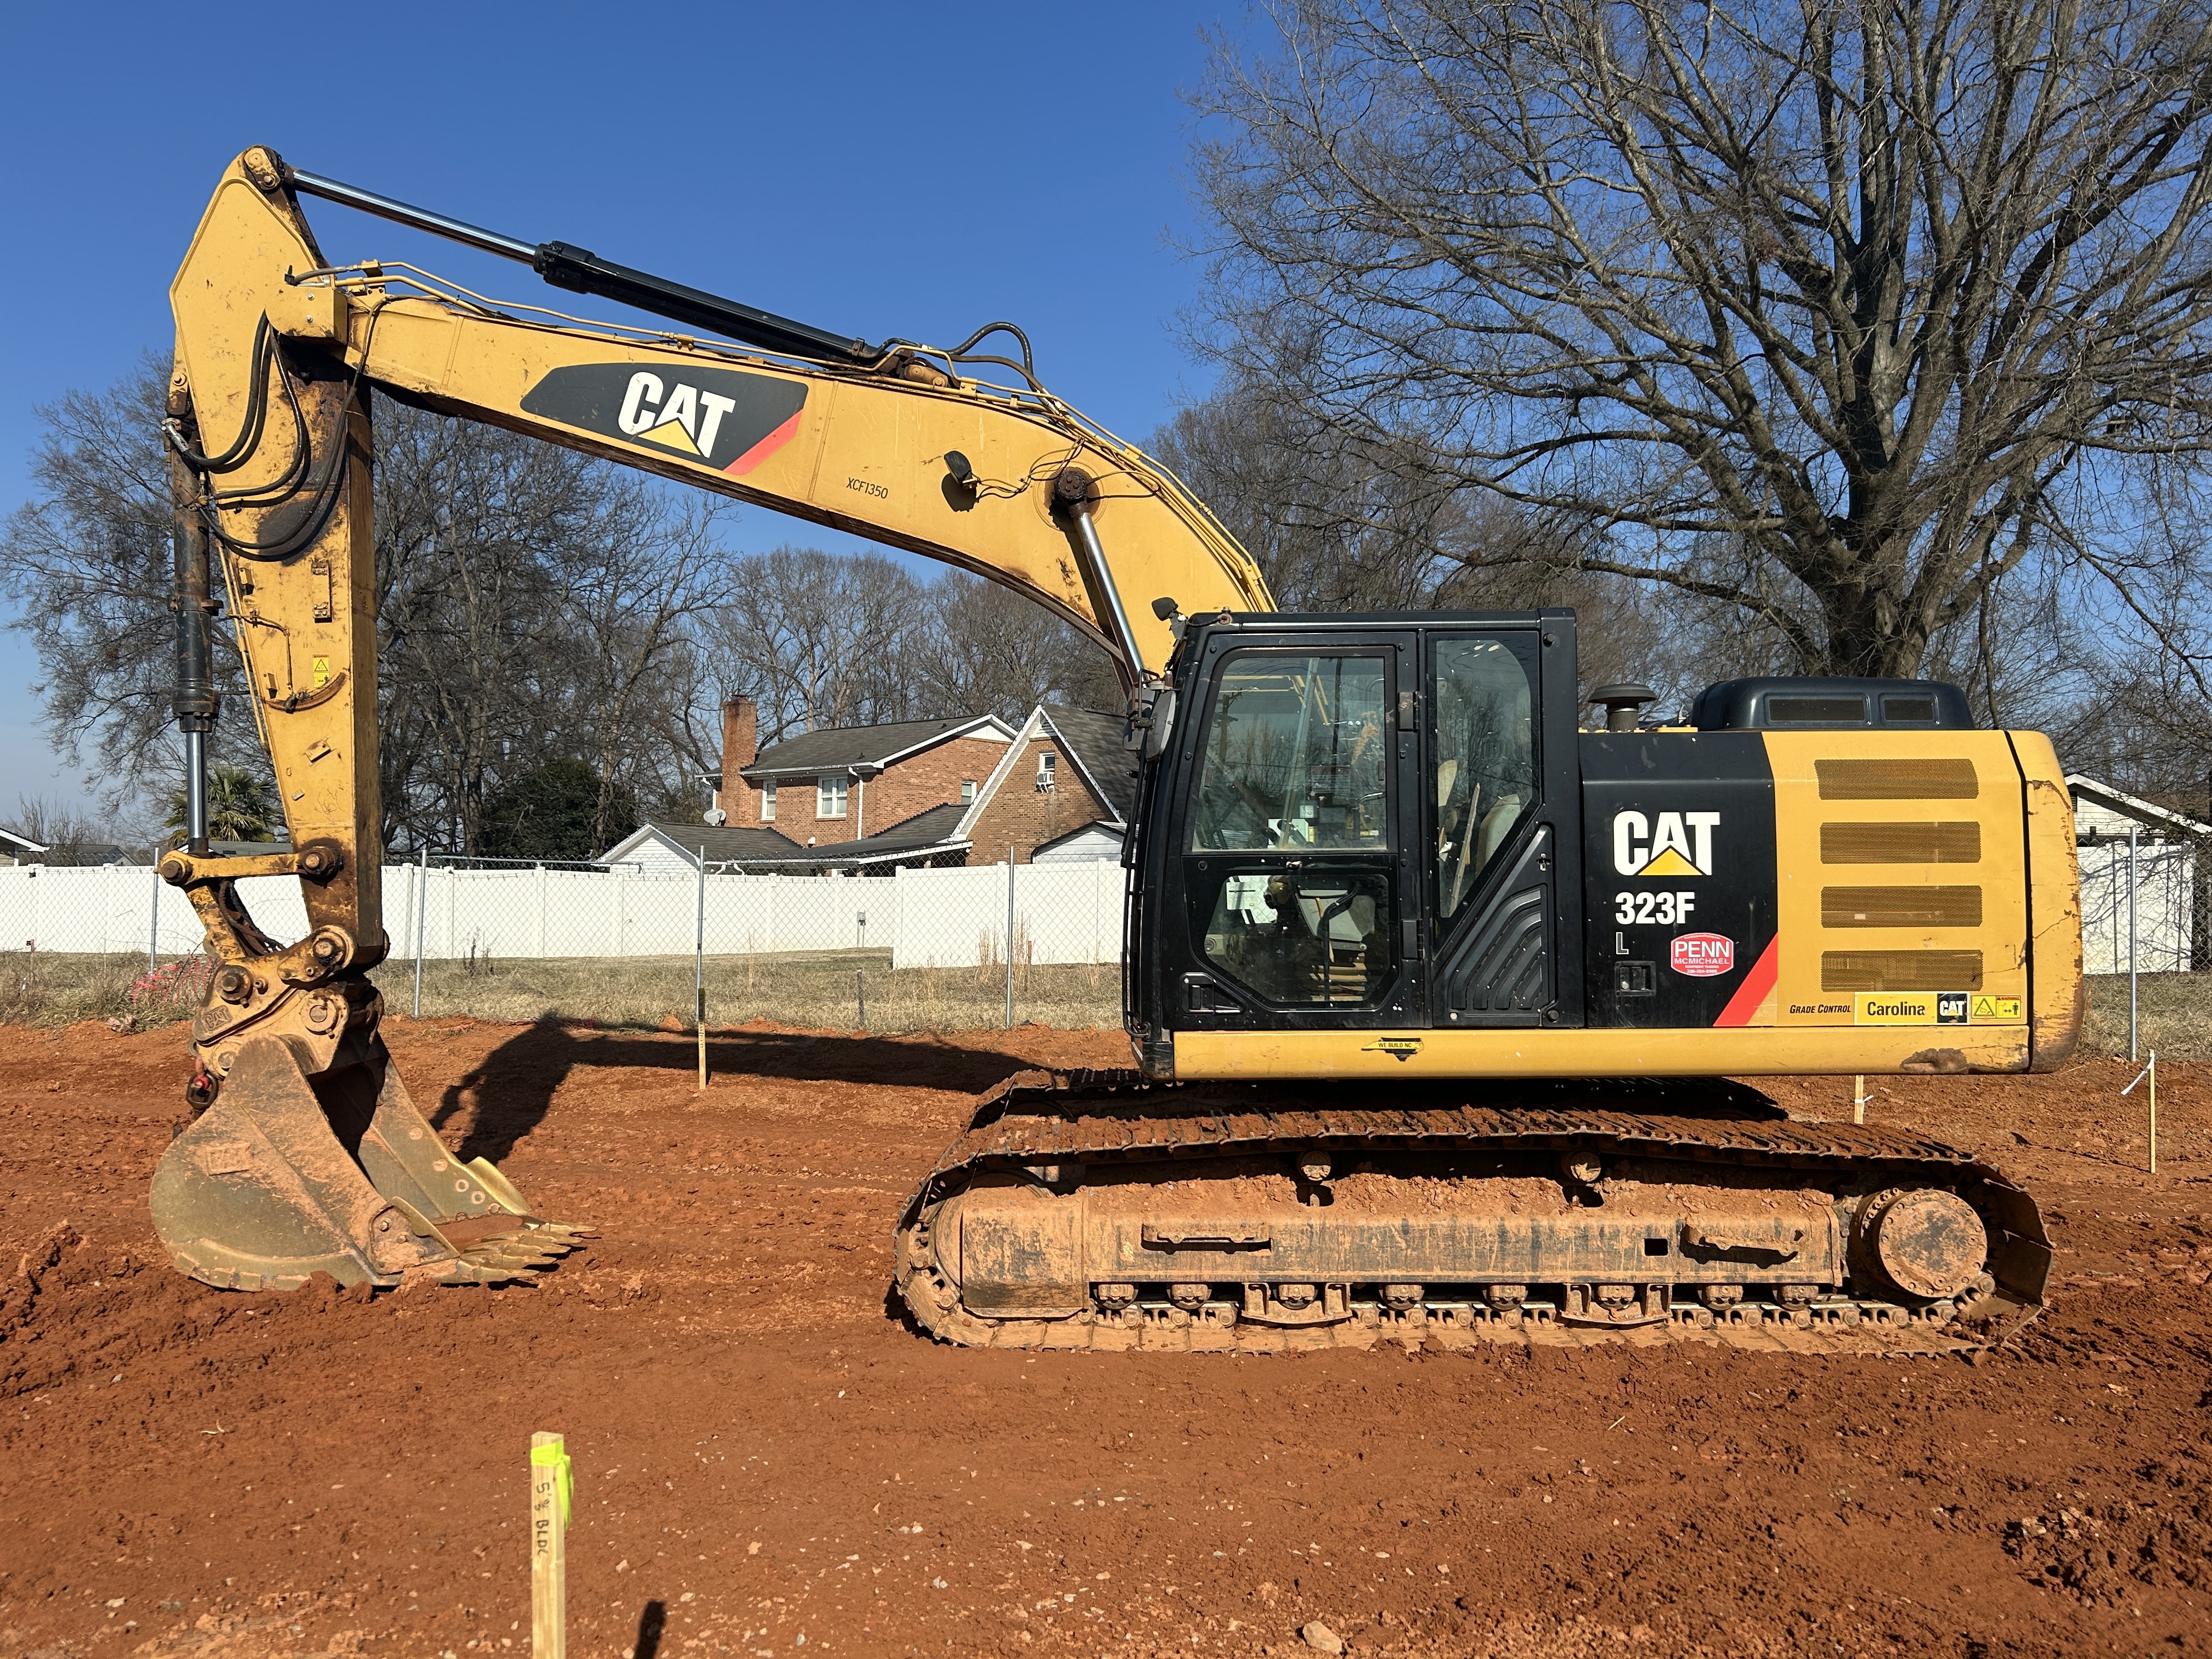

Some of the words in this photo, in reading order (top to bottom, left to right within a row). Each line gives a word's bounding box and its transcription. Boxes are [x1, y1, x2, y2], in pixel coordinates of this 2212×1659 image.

[618, 371, 736, 459] CAT
[846, 477, 888, 499] XCF1350
[1613, 810, 1720, 876] CAT
[1615, 891, 1695, 924] 323F
[1616, 932, 1629, 955] L
[1675, 941, 1729, 957] PENN
[204, 1007, 229, 1030] CAT
[1867, 1001, 1926, 1016] Carolina
[1939, 1000, 1965, 1017] CAT
